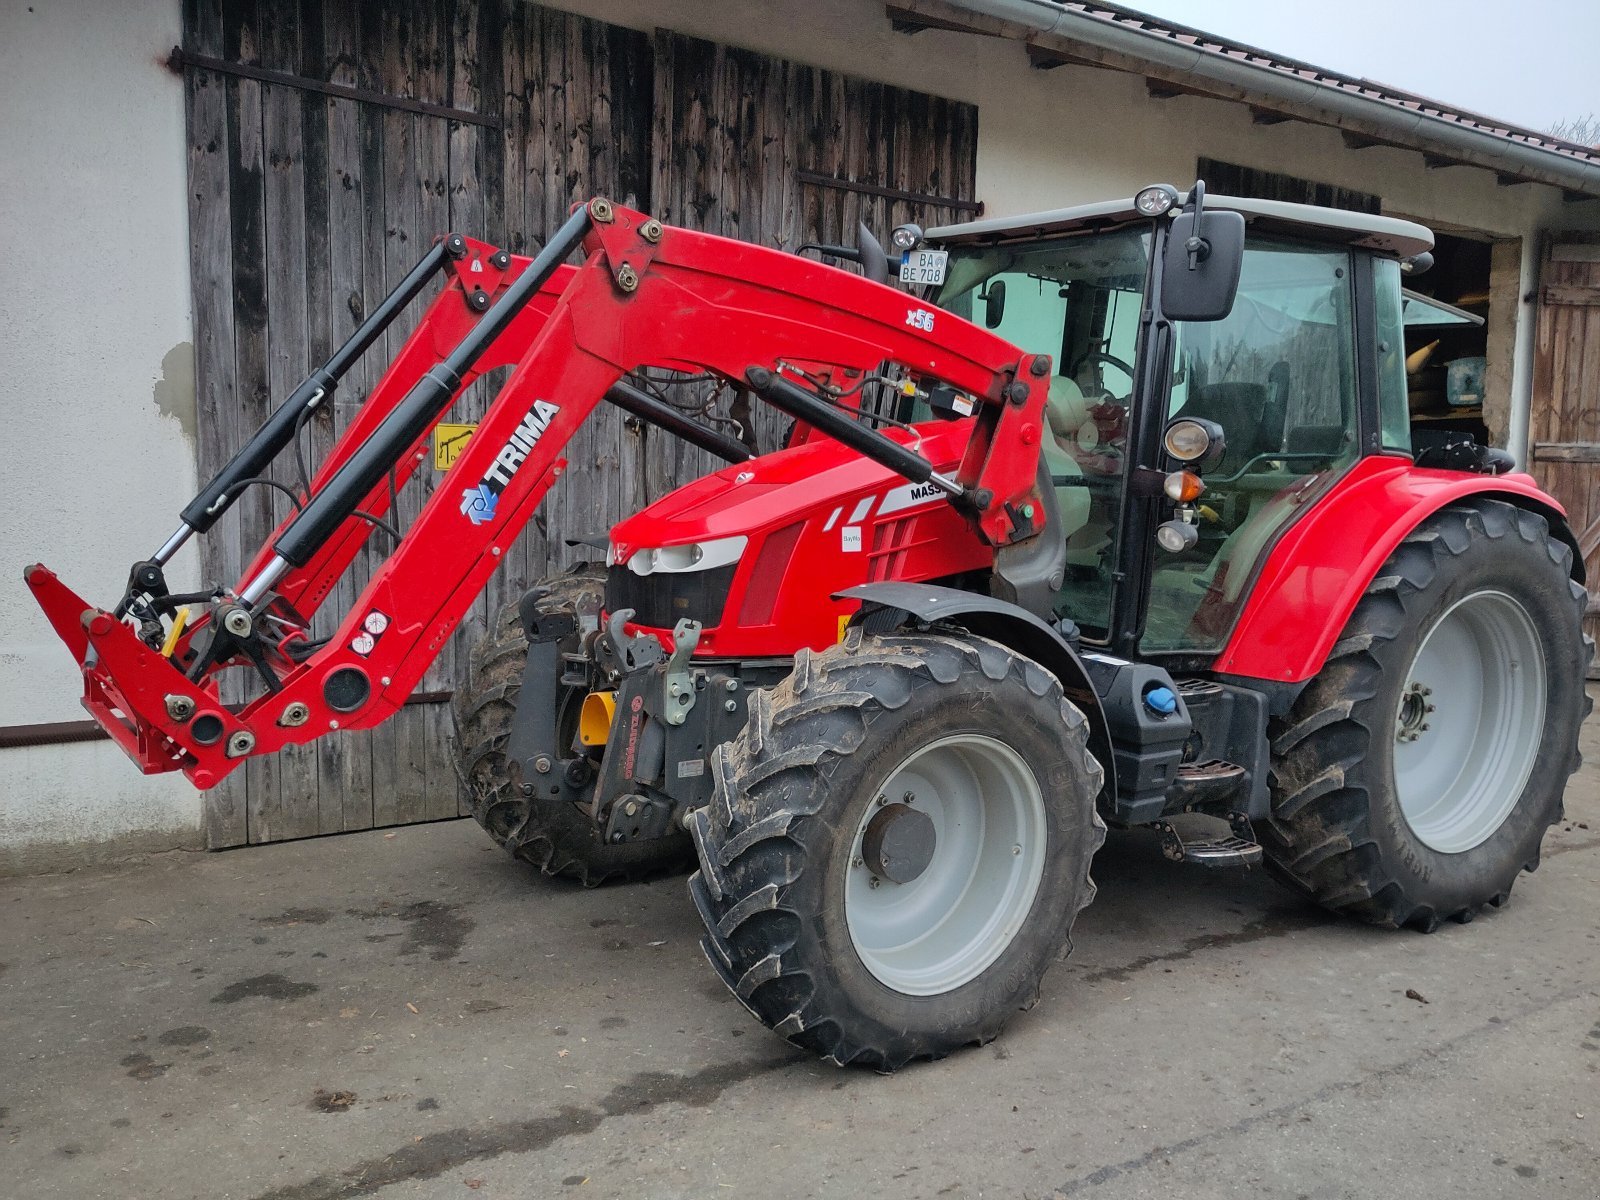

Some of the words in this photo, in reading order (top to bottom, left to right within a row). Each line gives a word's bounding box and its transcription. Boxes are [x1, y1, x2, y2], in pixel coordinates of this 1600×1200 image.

[920, 253, 934, 267] BA
[902, 267, 917, 281] BE
[920, 268, 941, 282] 708
[905, 308, 935, 333] x56
[483, 399, 561, 487] TRIMA
[910, 484, 943, 501] MASS
[624, 713, 640, 780] ZUIDBERG
